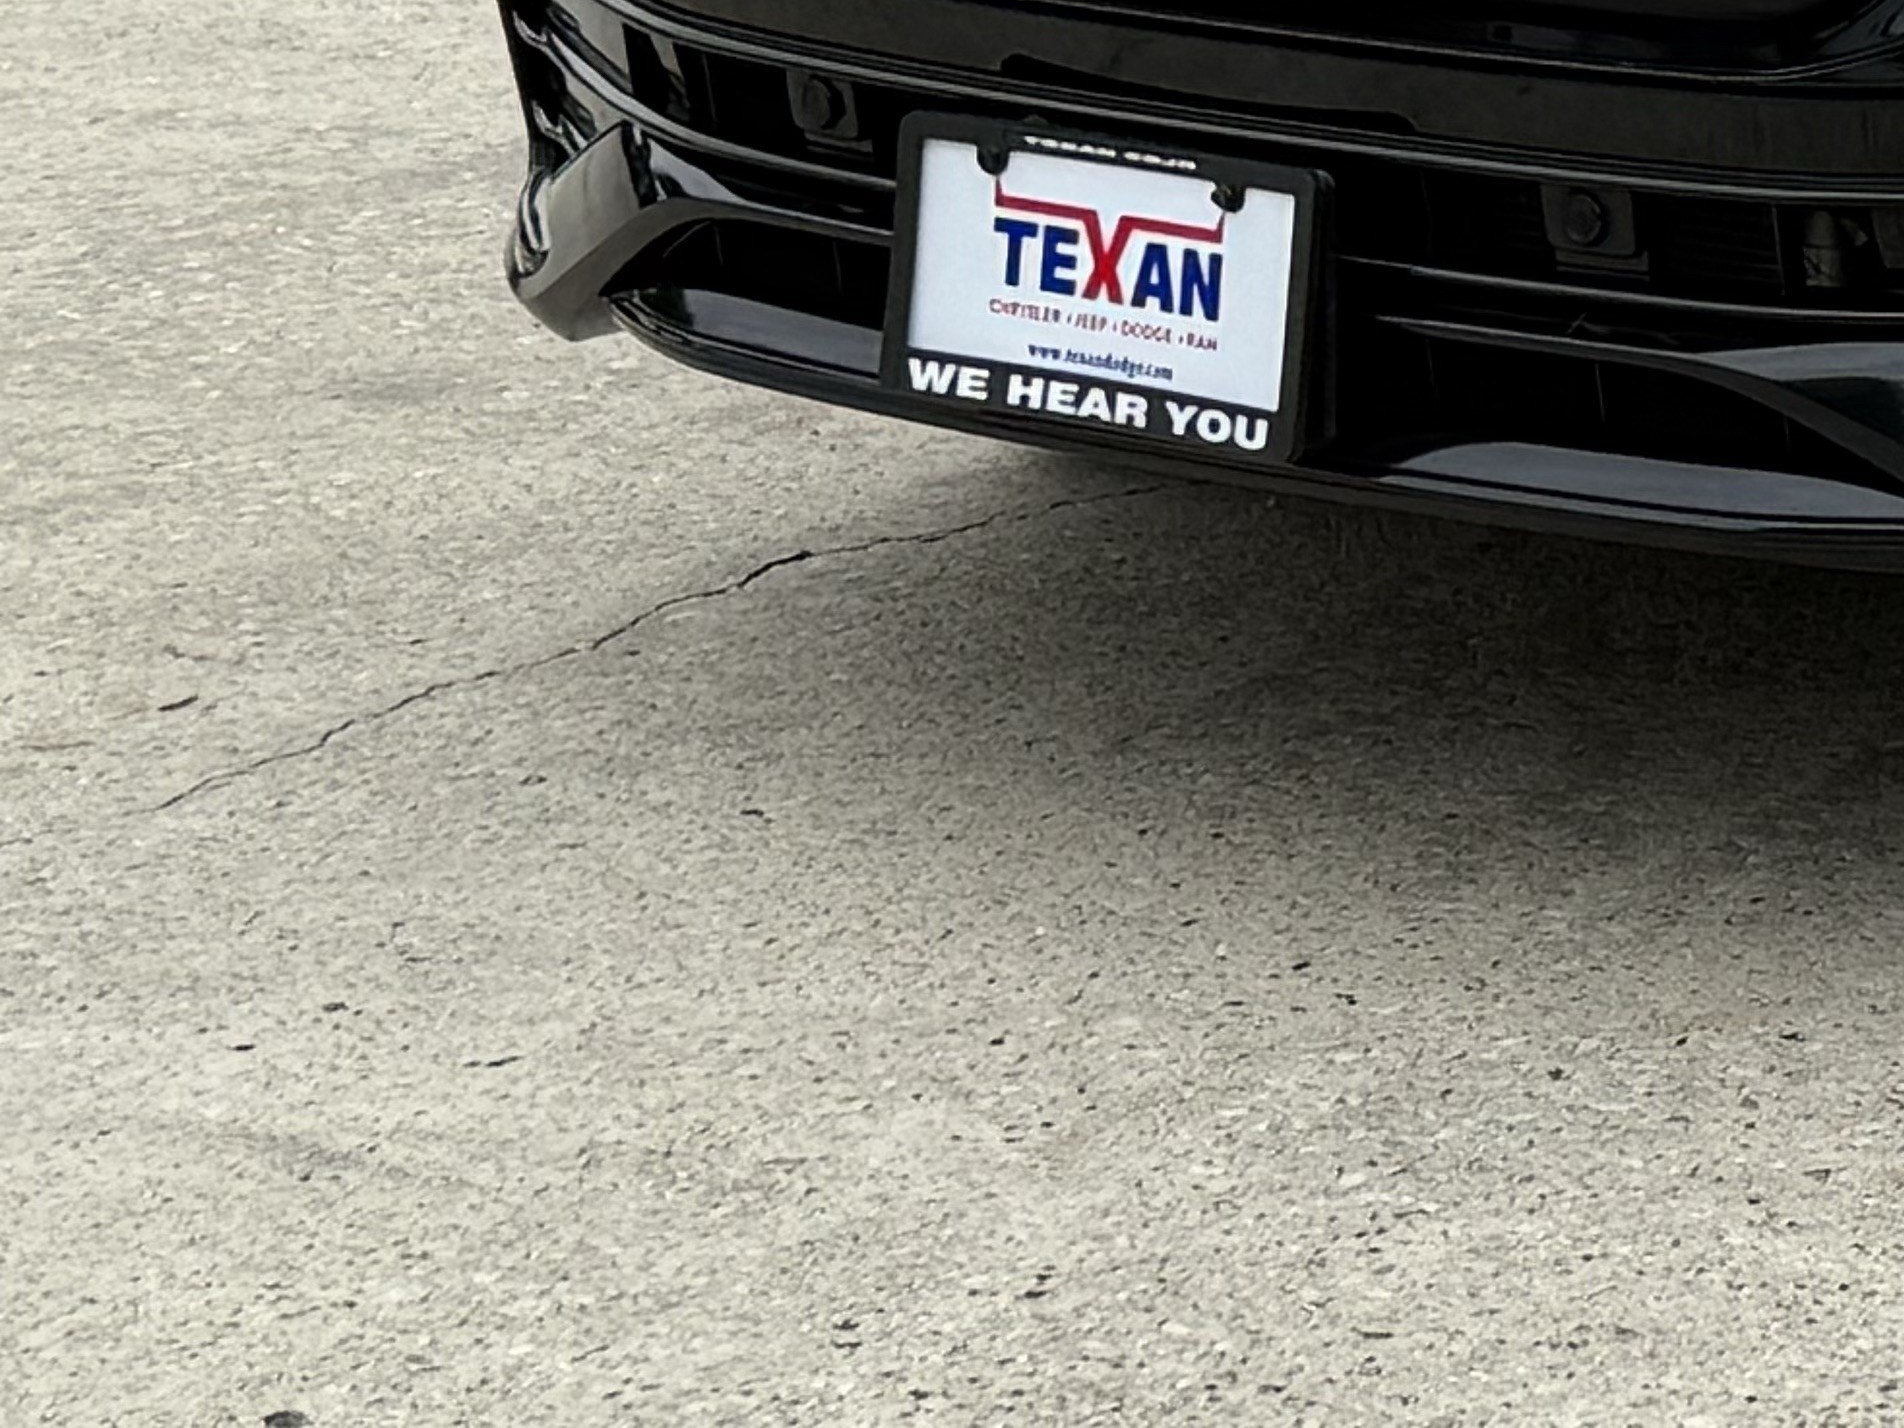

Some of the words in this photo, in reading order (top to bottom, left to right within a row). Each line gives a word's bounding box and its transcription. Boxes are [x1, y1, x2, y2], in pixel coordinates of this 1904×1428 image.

[993, 208, 1224, 322] TEXAN
[907, 357, 990, 402] WE
[1006, 373, 1149, 429] HEAR
[1165, 400, 1269, 451] YOU
